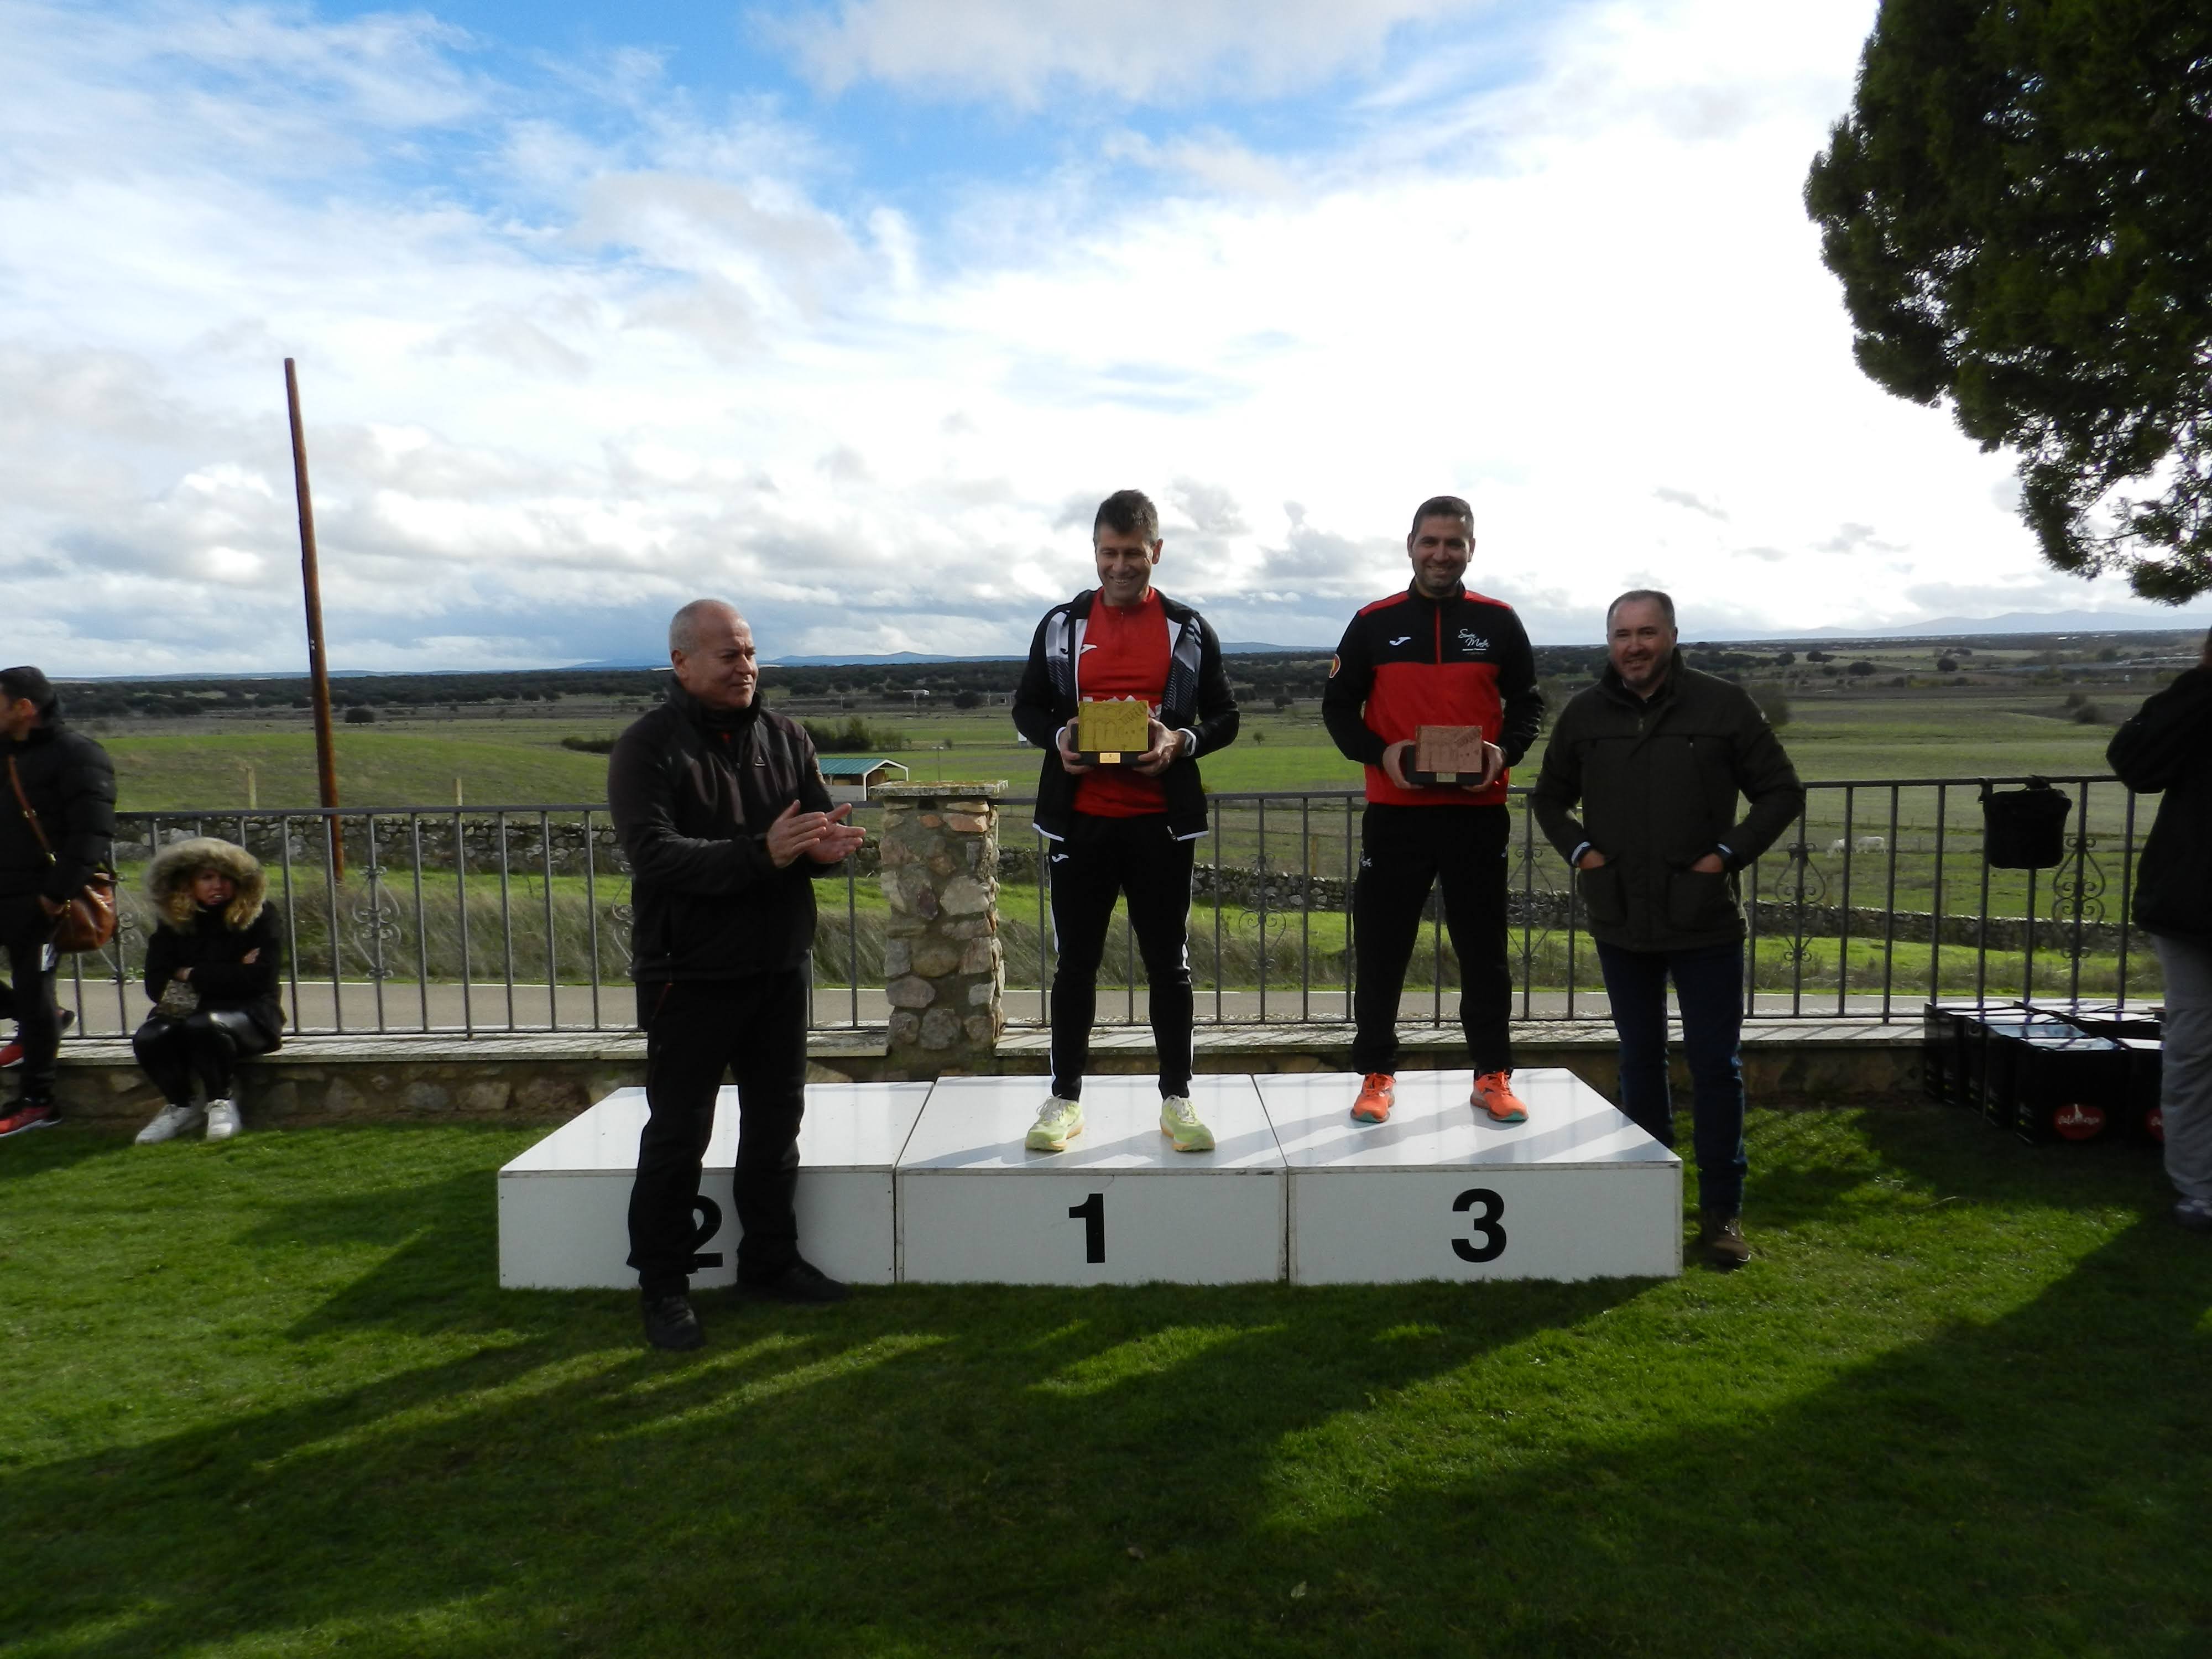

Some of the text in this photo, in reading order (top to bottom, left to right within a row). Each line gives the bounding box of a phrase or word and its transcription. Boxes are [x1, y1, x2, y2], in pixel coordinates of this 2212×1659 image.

[686, 1194, 724, 1268] 2
[1068, 1193, 1105, 1264] 1
[1451, 1188, 1507, 1263] 3
